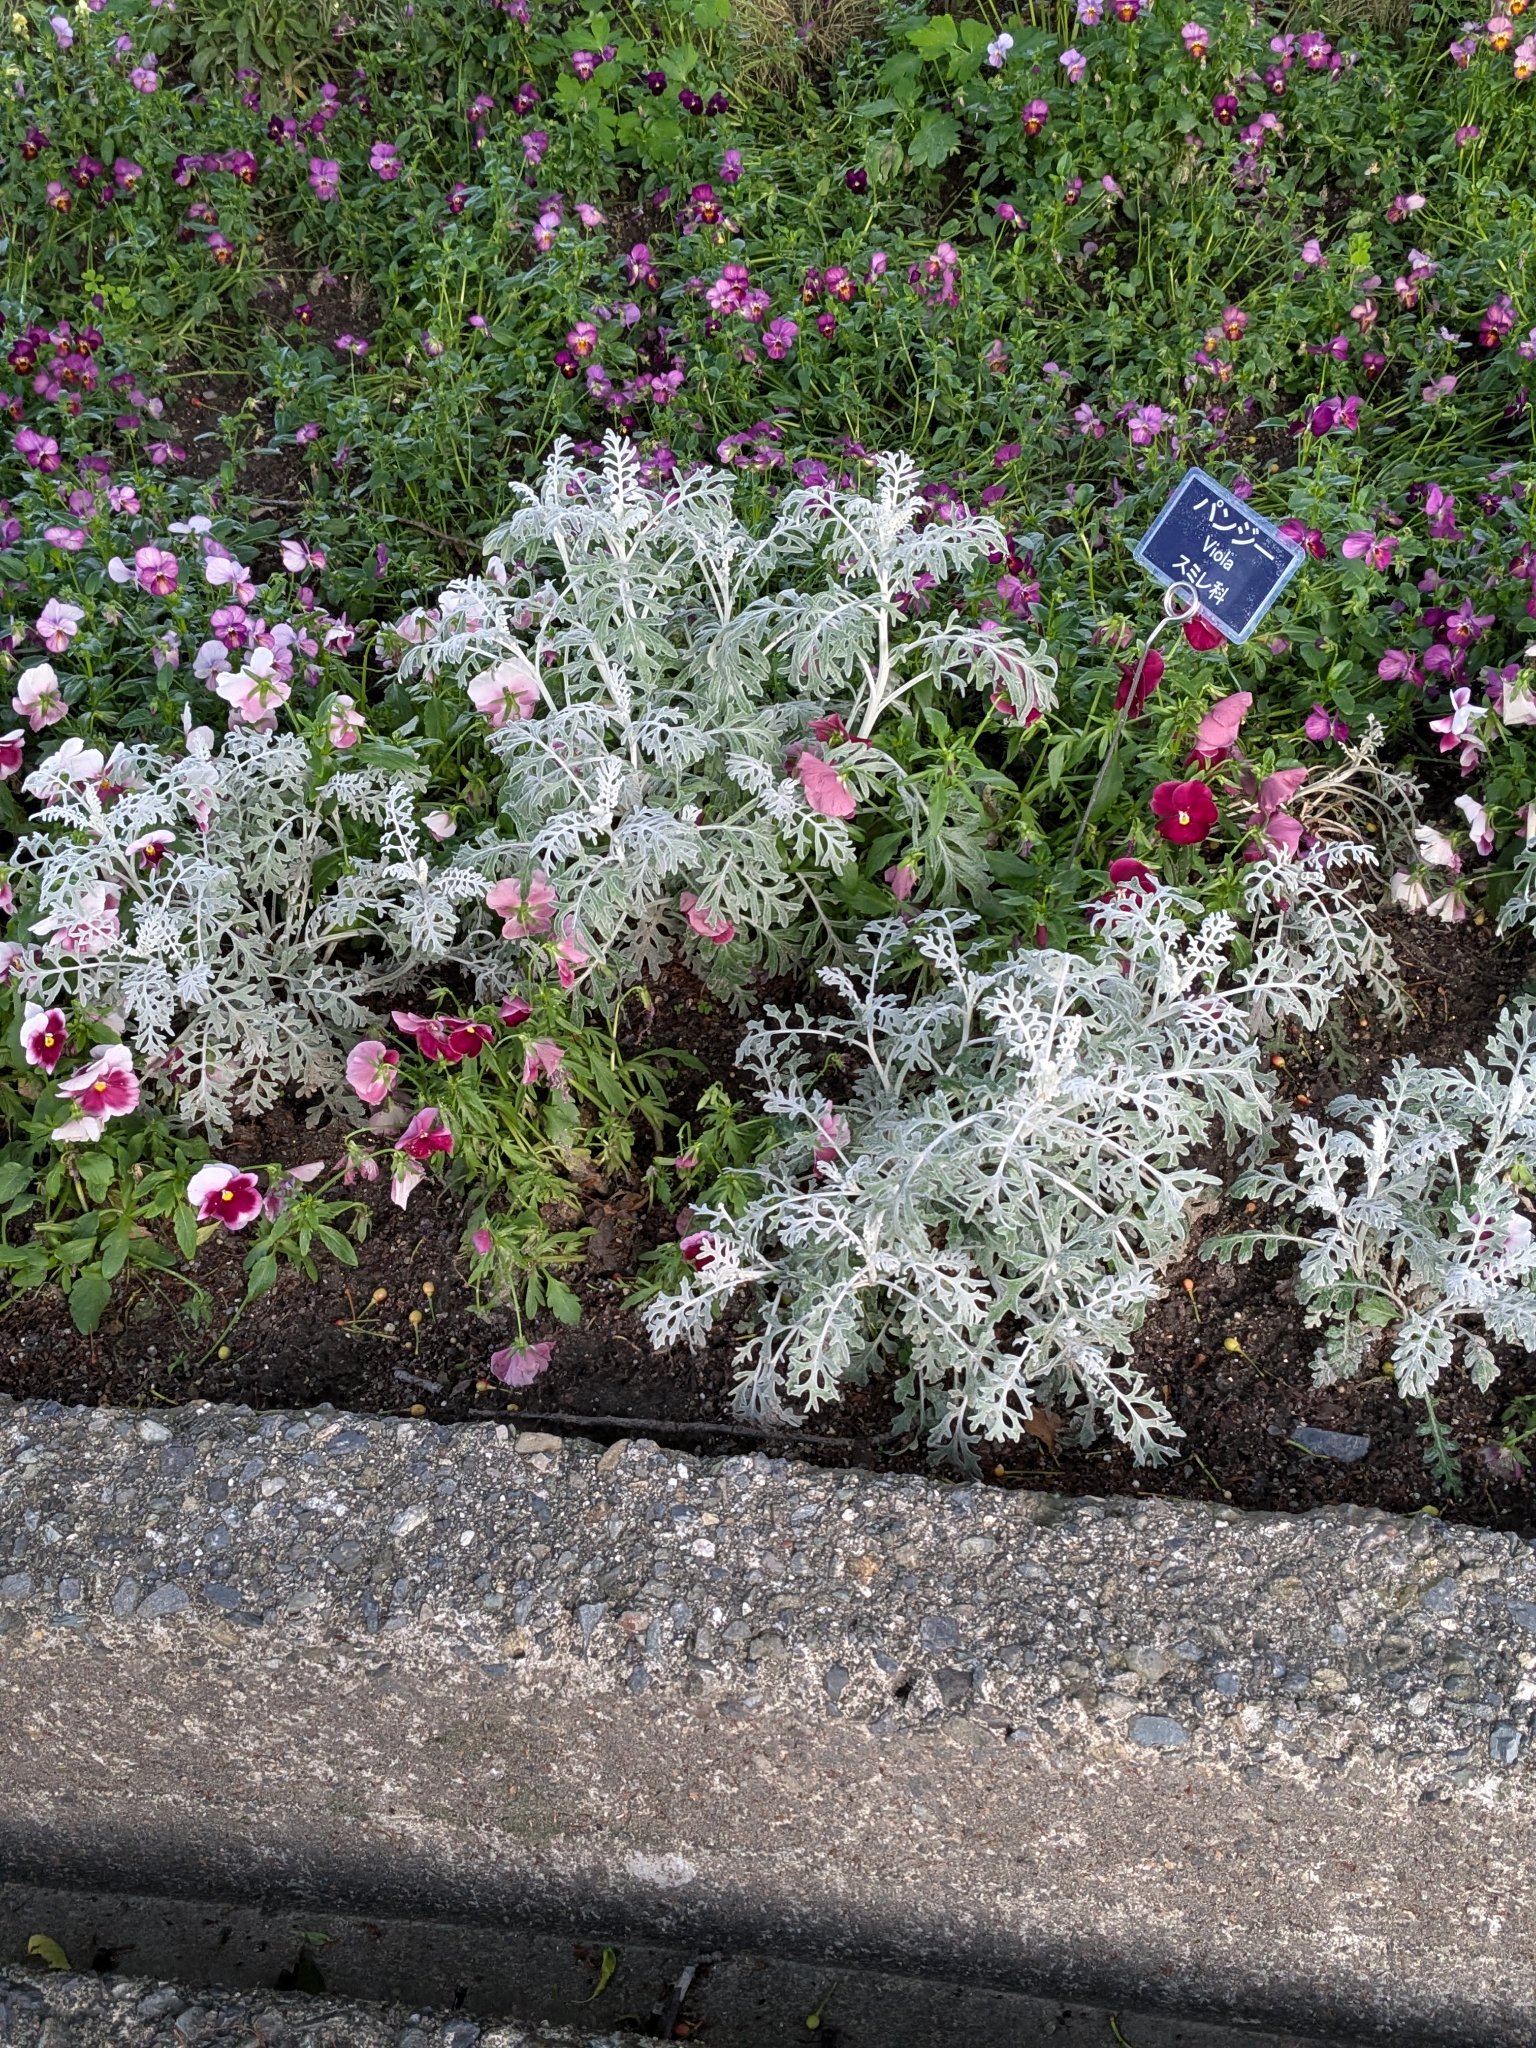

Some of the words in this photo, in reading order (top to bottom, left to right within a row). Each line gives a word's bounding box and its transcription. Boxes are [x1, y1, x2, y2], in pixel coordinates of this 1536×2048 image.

[1193, 498, 1275, 561] パンジー
[1202, 535, 1234, 572] Viola
[1172, 554, 1229, 606] スミレ科
